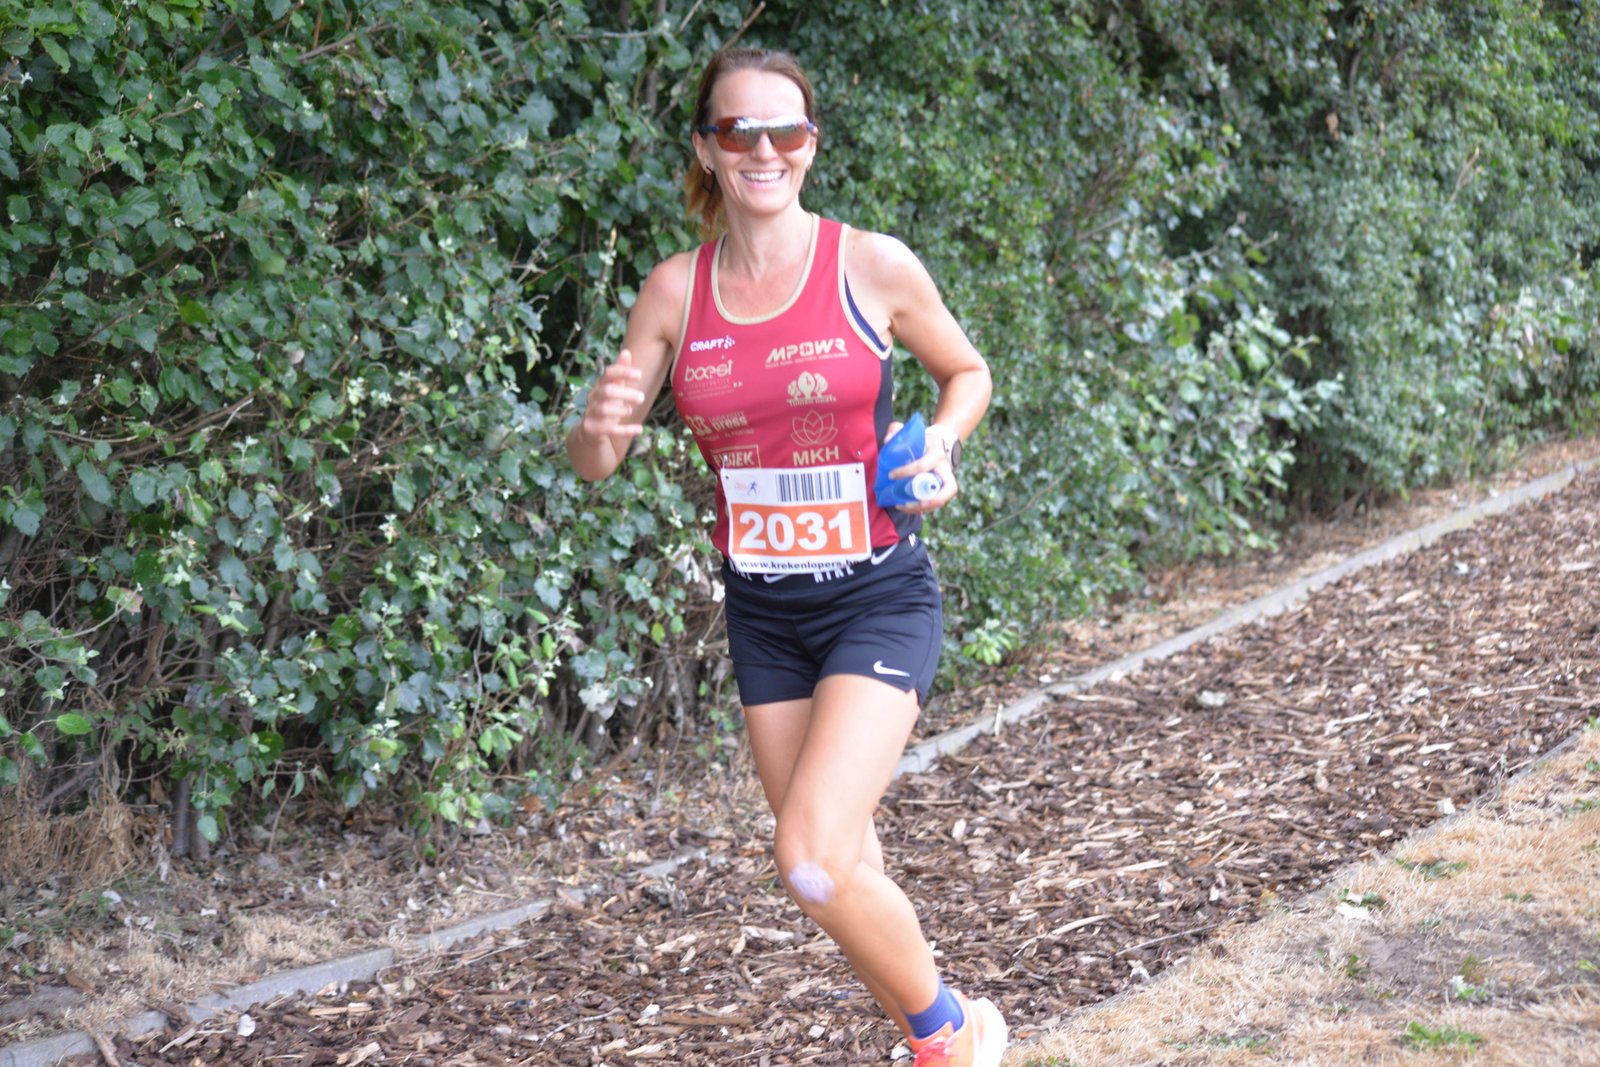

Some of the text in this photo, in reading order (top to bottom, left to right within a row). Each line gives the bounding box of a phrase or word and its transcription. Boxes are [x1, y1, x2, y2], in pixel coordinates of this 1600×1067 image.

[690, 338, 724, 352] CRAFT
[765, 336, 847, 363] MPOWR
[792, 446, 839, 466] MKH
[738, 509, 853, 551] 2031
[741, 559, 860, 570] www.krekenlopers.be
